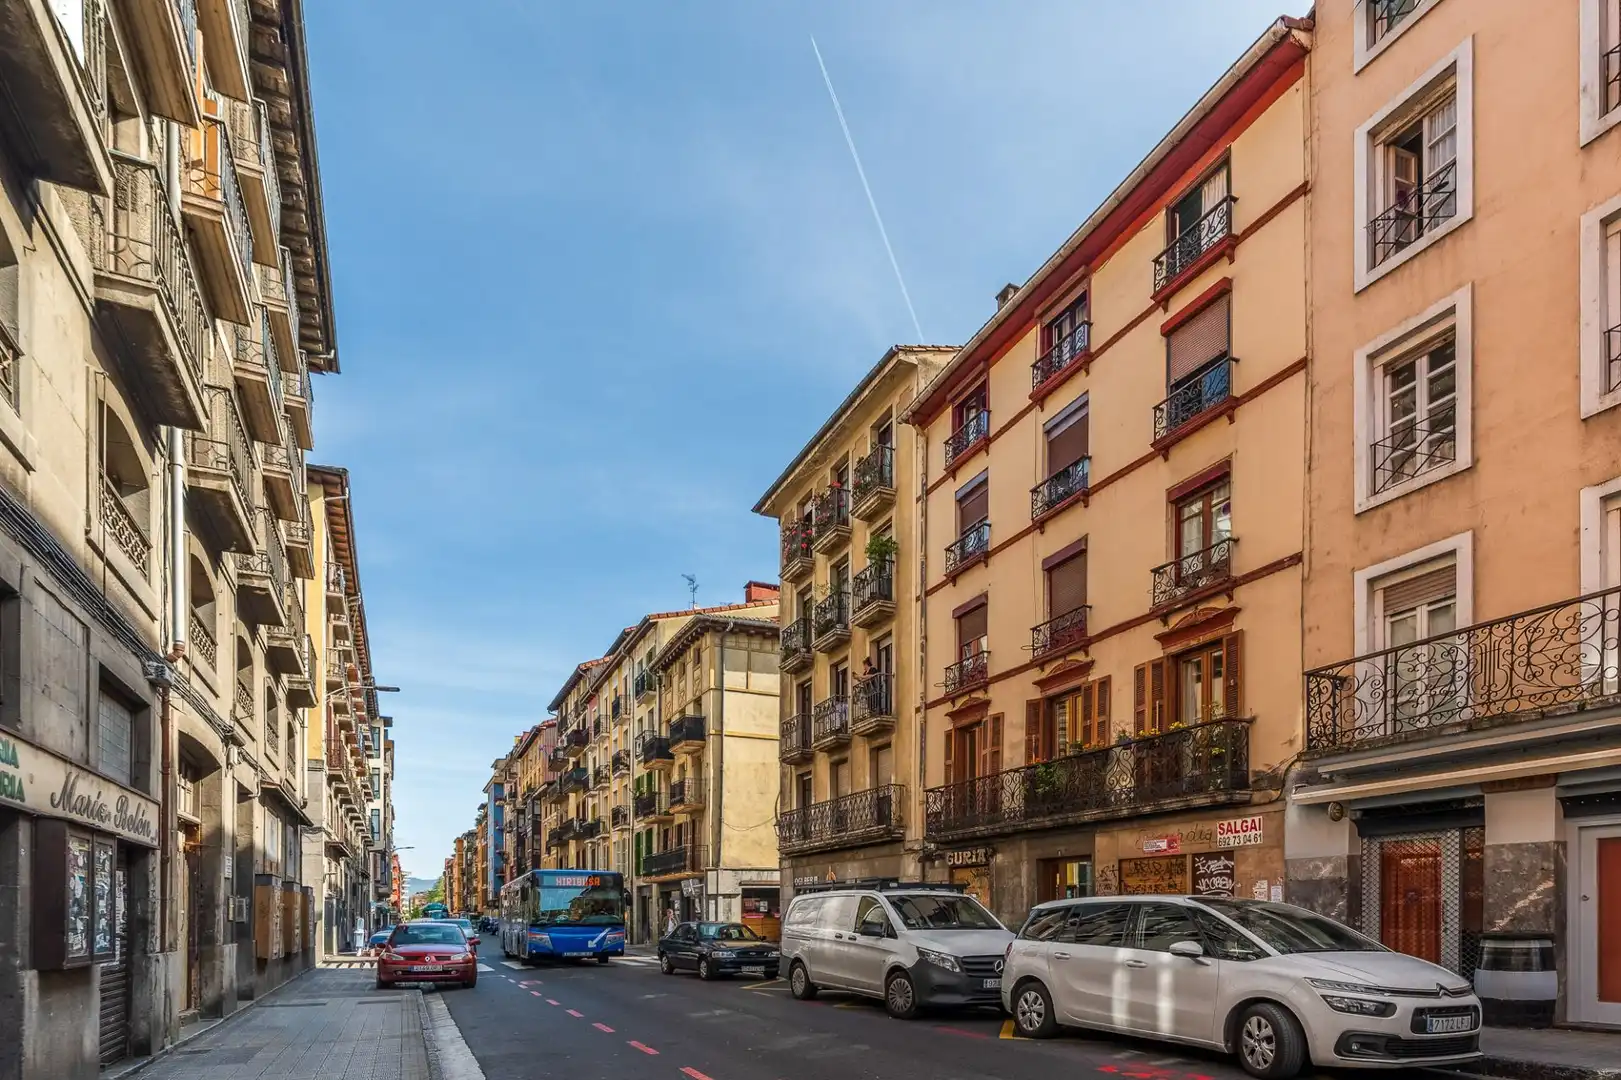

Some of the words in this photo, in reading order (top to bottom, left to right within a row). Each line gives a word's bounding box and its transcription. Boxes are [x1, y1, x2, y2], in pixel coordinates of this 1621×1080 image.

[1218, 818, 1262, 836] SALGAI
[1218, 837, 1231, 847] 692
[1233, 835, 1242, 846] 73
[1243, 834, 1252, 844] 04
[1253, 833, 1262, 843] 61
